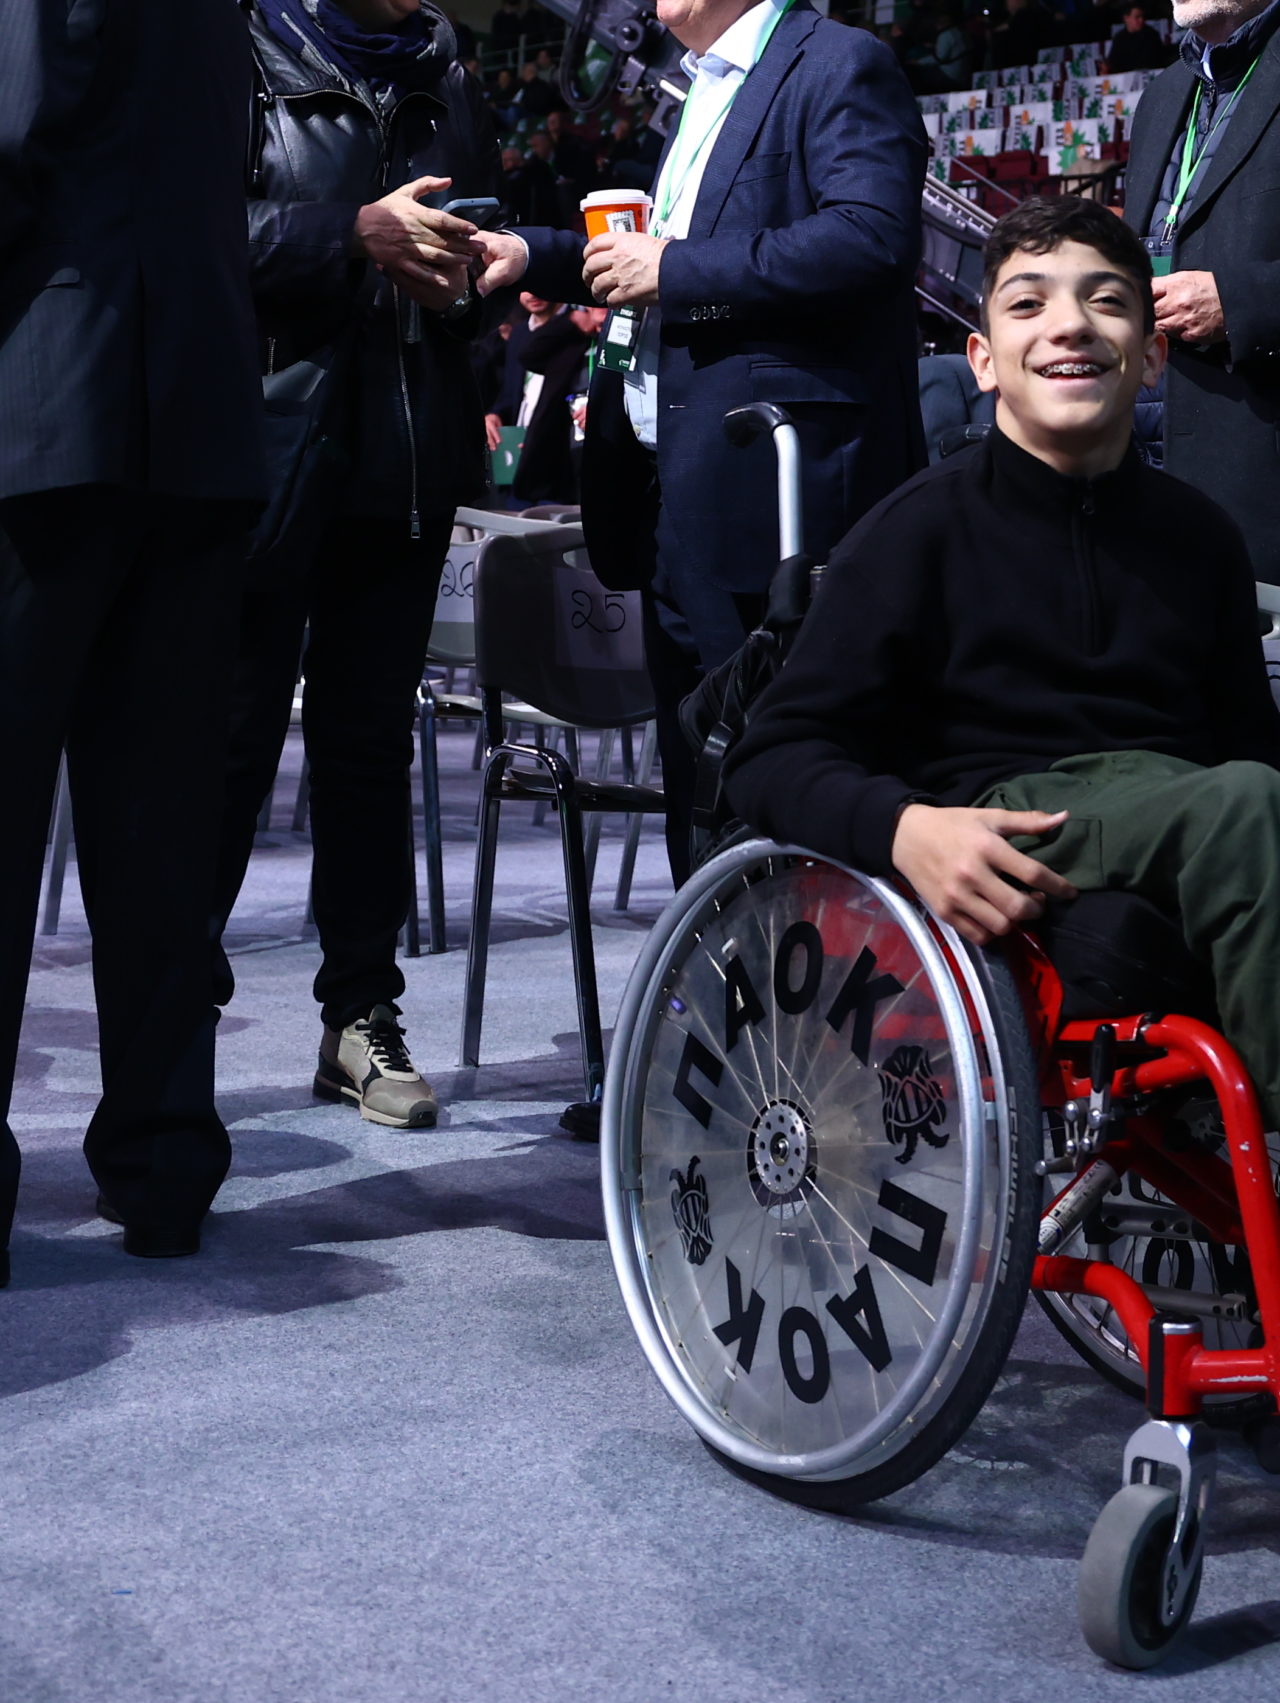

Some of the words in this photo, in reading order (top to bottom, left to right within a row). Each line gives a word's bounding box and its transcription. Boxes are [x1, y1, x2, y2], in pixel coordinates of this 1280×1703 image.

[571, 589, 626, 633] 25
[672, 920, 905, 1130] ΠΑΟΚ
[712, 1177, 947, 1404] ΠΑΟΚ
